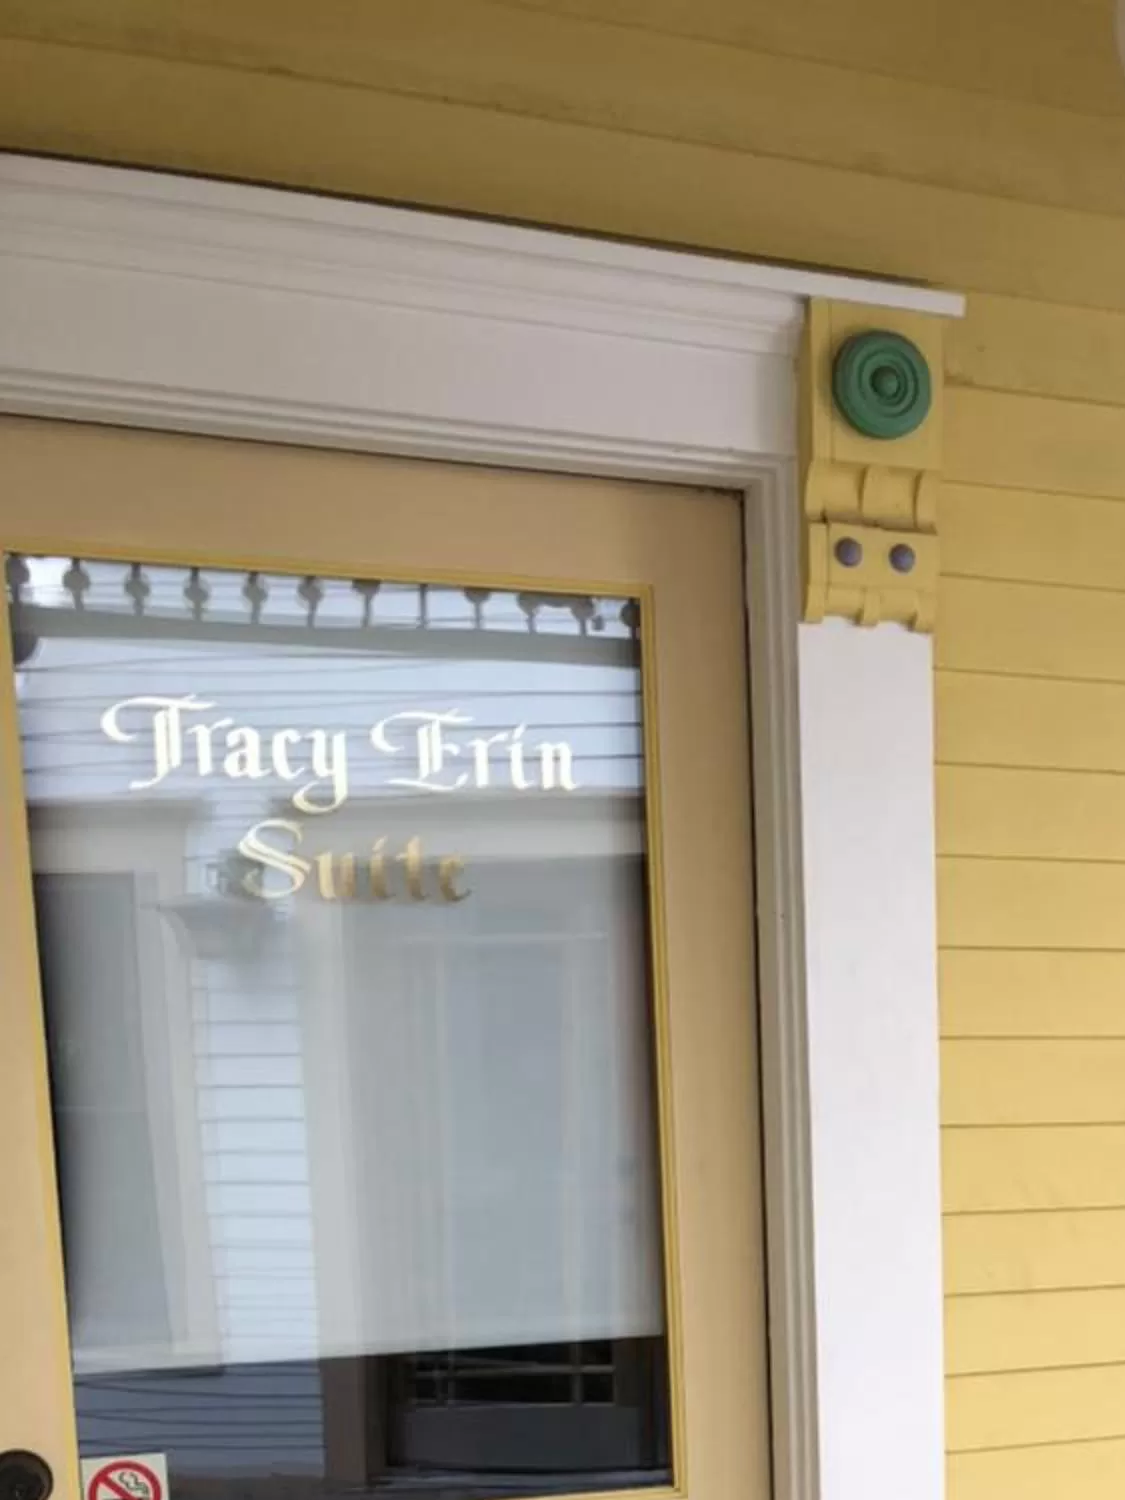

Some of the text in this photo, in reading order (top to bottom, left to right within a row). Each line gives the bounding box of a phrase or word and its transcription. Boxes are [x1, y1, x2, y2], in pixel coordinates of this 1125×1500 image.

[103, 694, 577, 813] Tracy Erin
[239, 819, 472, 902] Suite
